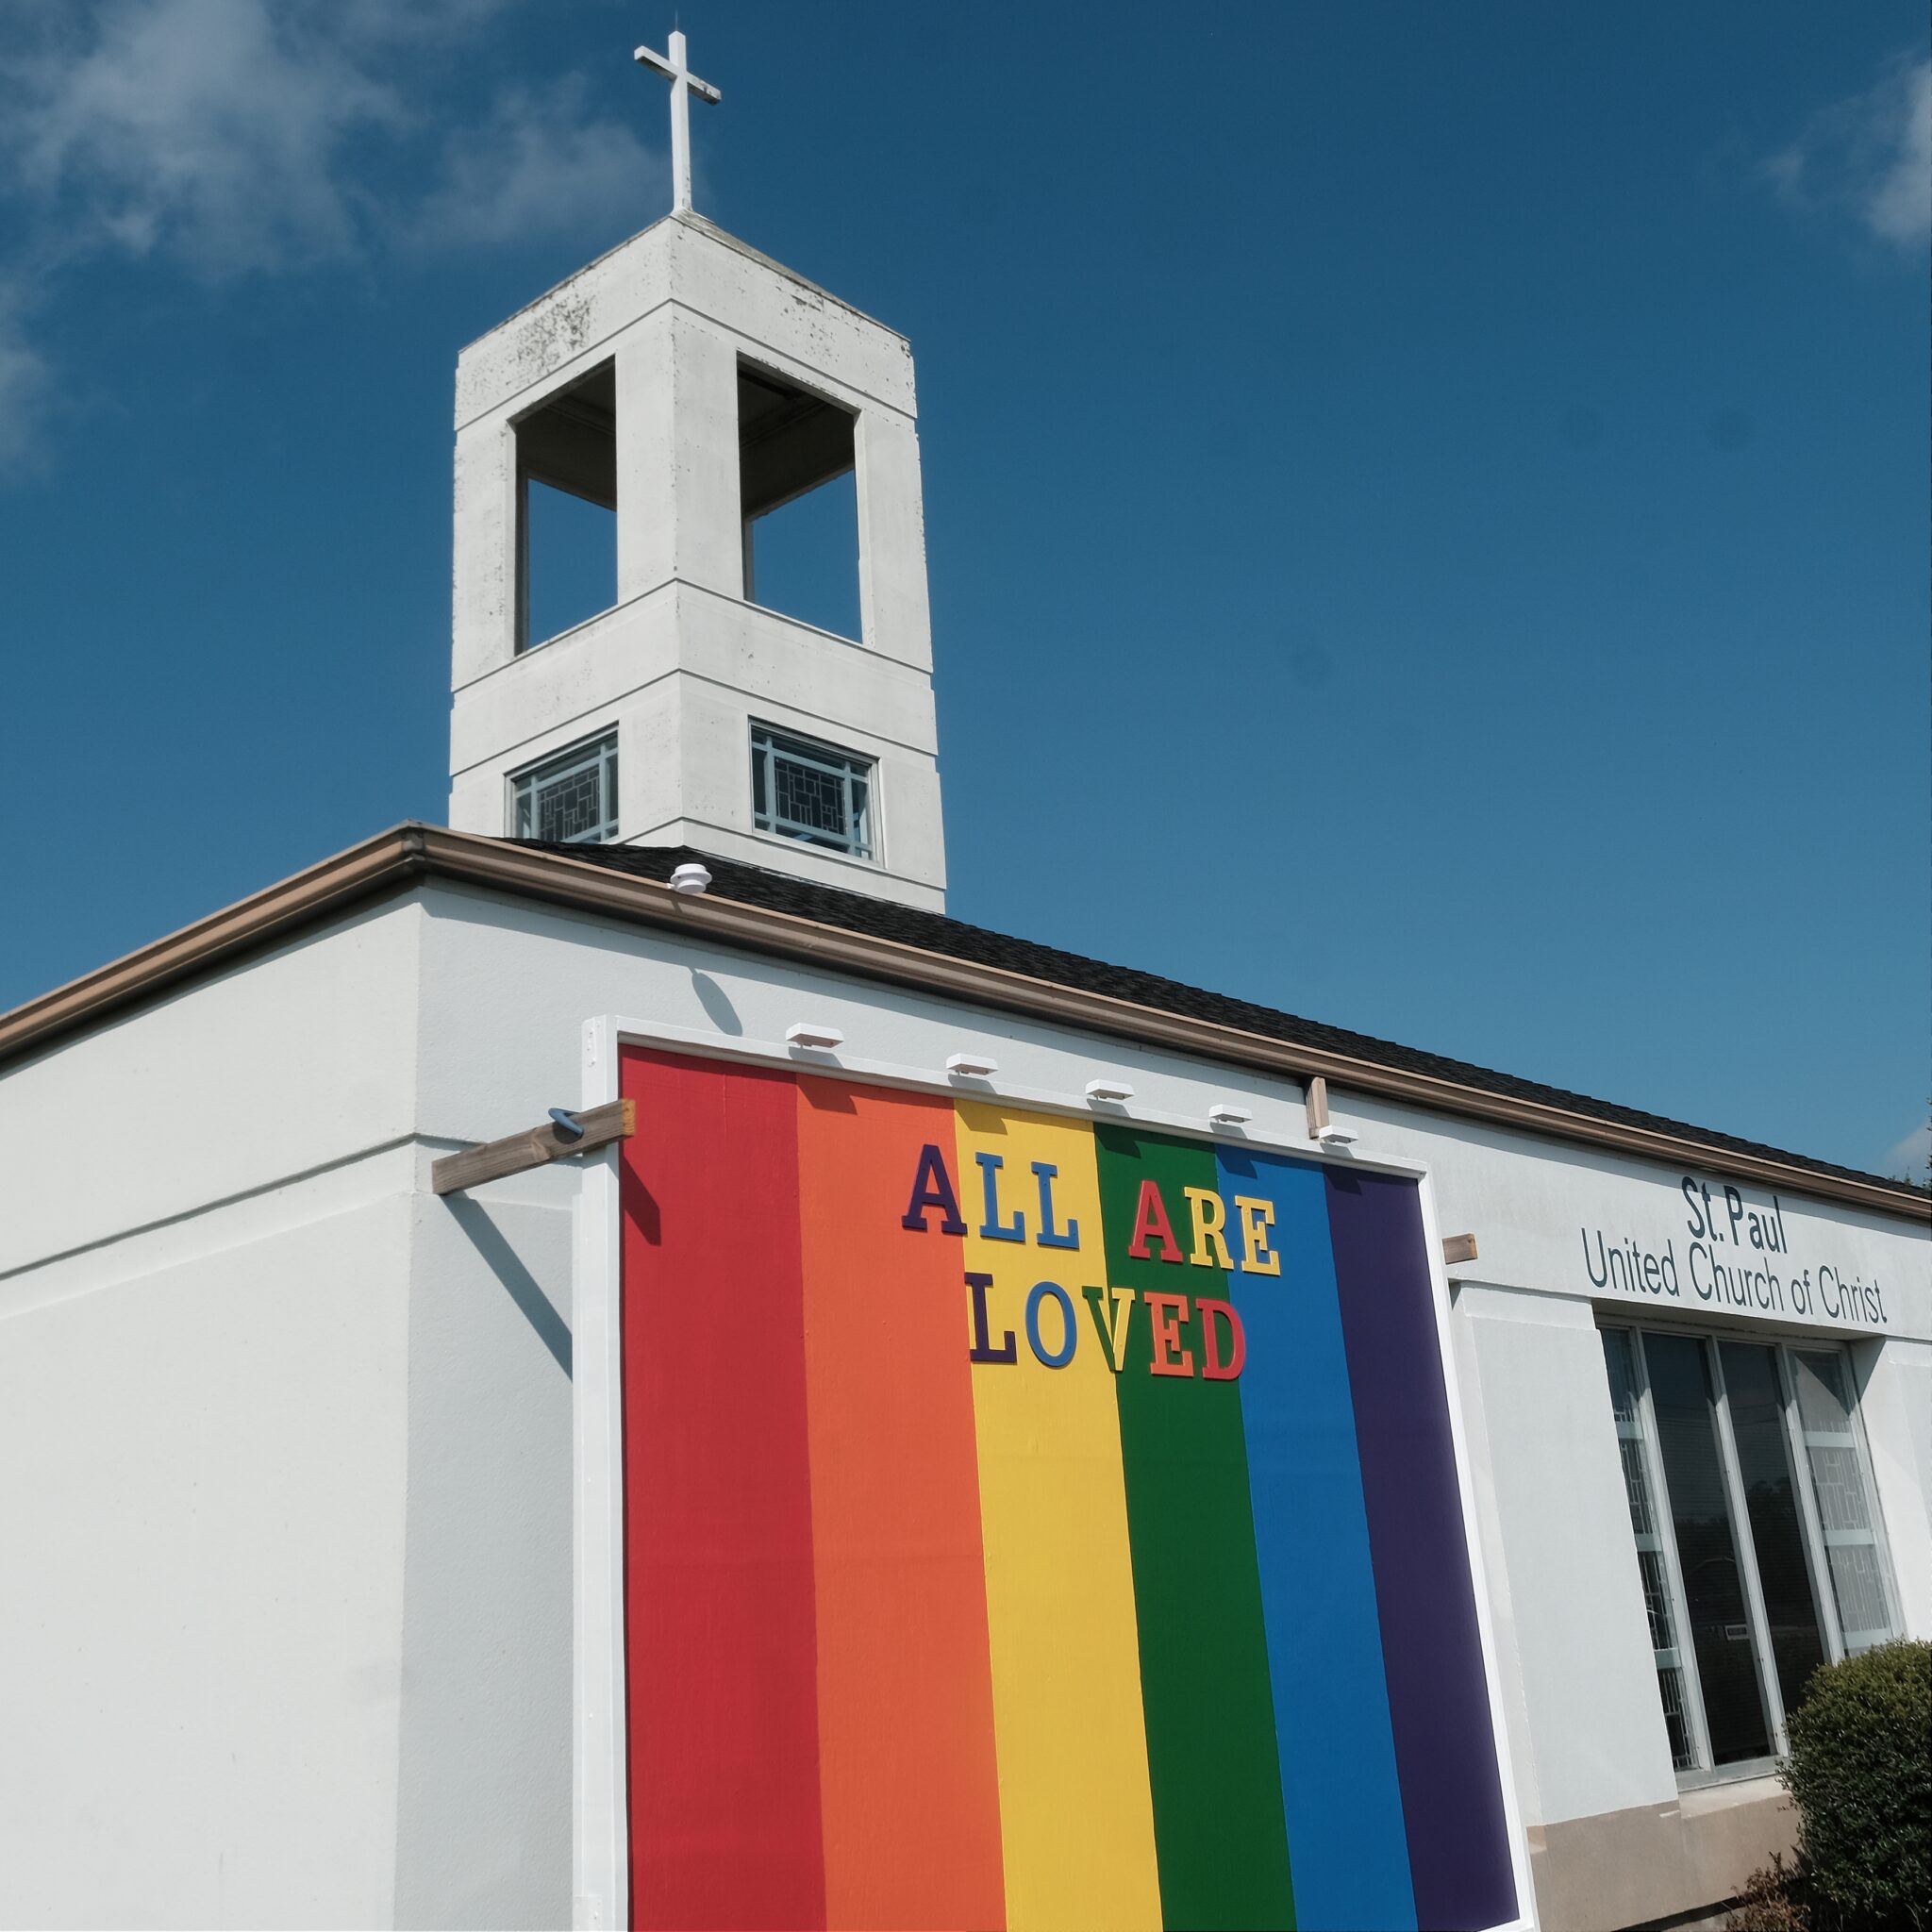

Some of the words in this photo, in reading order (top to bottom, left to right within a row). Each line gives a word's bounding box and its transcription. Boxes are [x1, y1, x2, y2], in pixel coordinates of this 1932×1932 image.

[901, 1144, 1080, 1250] ALL
[1128, 1179, 1281, 1276] ARE
[1681, 1175, 1724, 1242] St.
[1724, 1185, 1788, 1254] Paul
[964, 1272, 1247, 1381] LOVED
[1581, 1227, 1680, 1297] United
[1689, 1241, 1785, 1311] Church
[1790, 1269, 1814, 1316] of
[1818, 1264, 1888, 1324] Christ
